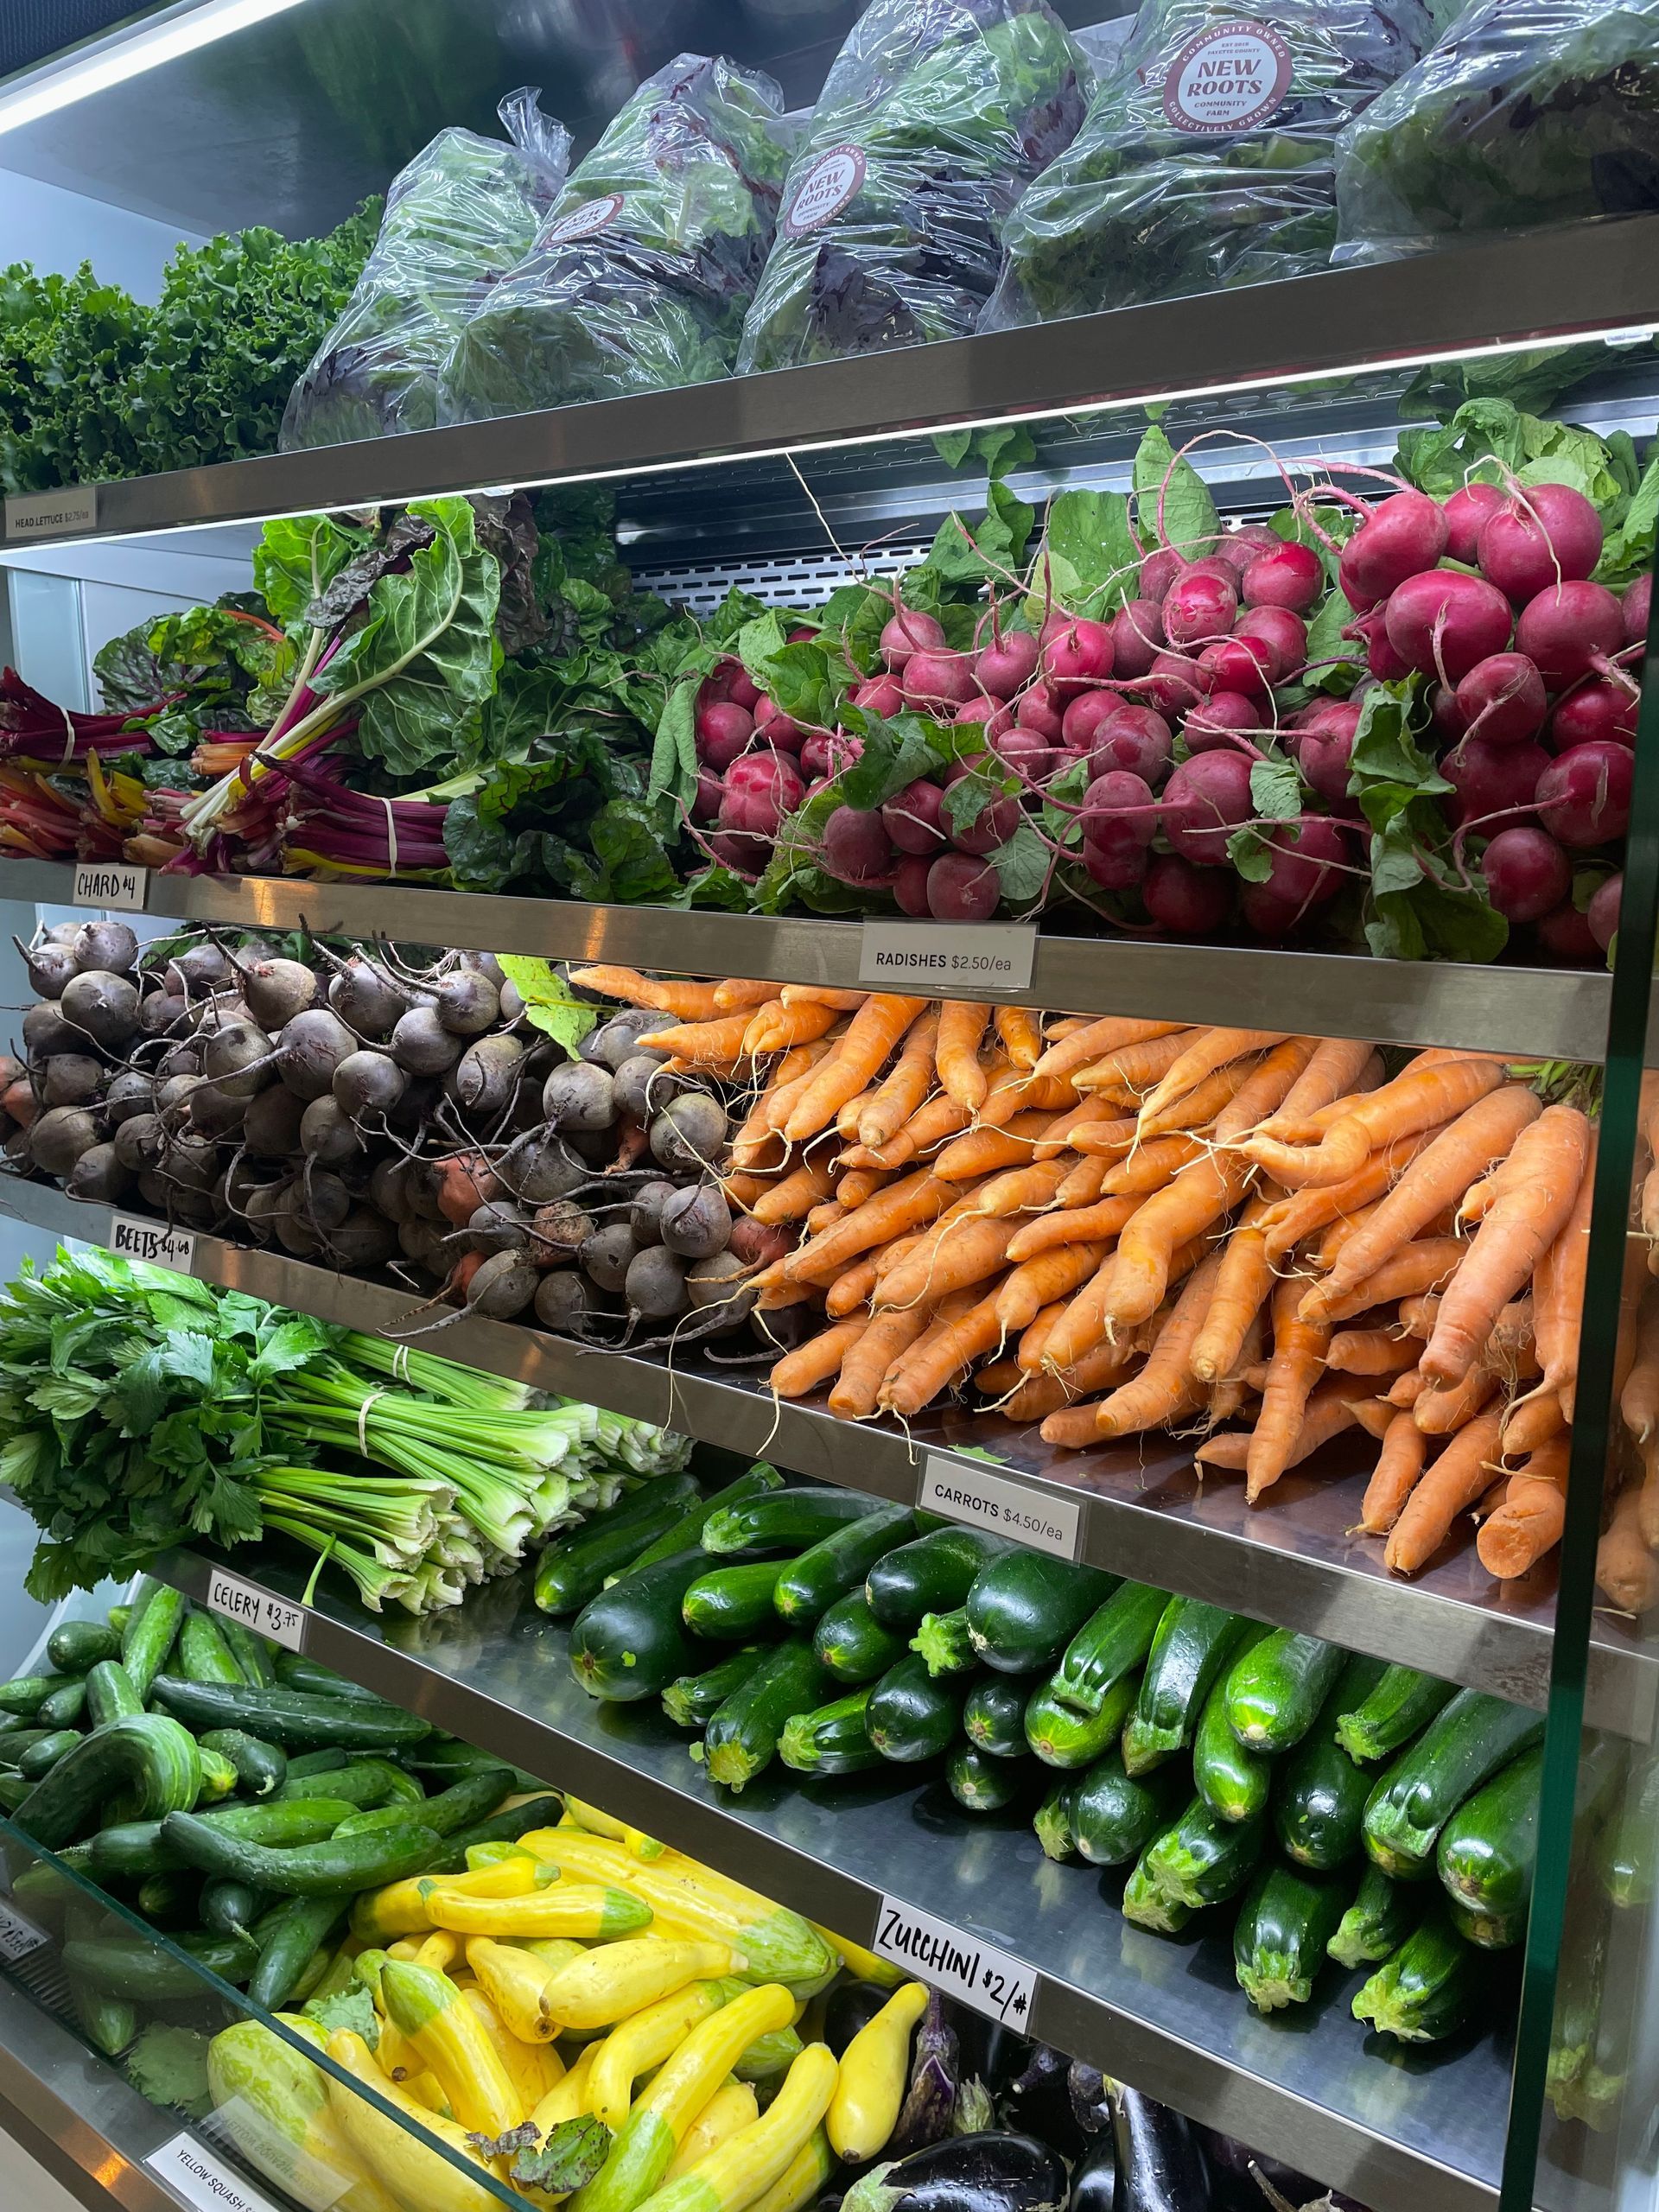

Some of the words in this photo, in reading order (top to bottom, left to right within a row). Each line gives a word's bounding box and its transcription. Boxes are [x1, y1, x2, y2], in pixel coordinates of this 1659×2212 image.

[1182, 26, 1252, 61] COMMUNITY
[1255, 29, 1285, 58] OWNED
[1198, 59, 1262, 79] NEW
[1186, 79, 1263, 98] ROOTS
[1169, 101, 1234, 132] COLLECTIVELY
[1238, 97, 1277, 126] GROWN
[805, 169, 845, 195] NEW
[797, 185, 842, 212] ROOTS
[15, 518, 34, 528] HEAD
[35, 513, 63, 527] LETTUCE
[78, 873, 119, 898] CHARD
[123, 874, 136, 899] $4
[876, 952, 946, 967] RADISHES
[951, 955, 1011, 970] $2.50/ea
[115, 1224, 158, 1259] BEETS
[935, 1484, 999, 1517] CARROTS
[1002, 1508, 1063, 1541] $4.50/ea
[214, 1582, 260, 1624] CELERY
[266, 1602, 299, 1630] $3.75
[879, 1909, 980, 1987] ZUCCHINI
[176, 2149, 213, 2180] YELLOW
[207, 2177, 245, 2210] SQUASH
